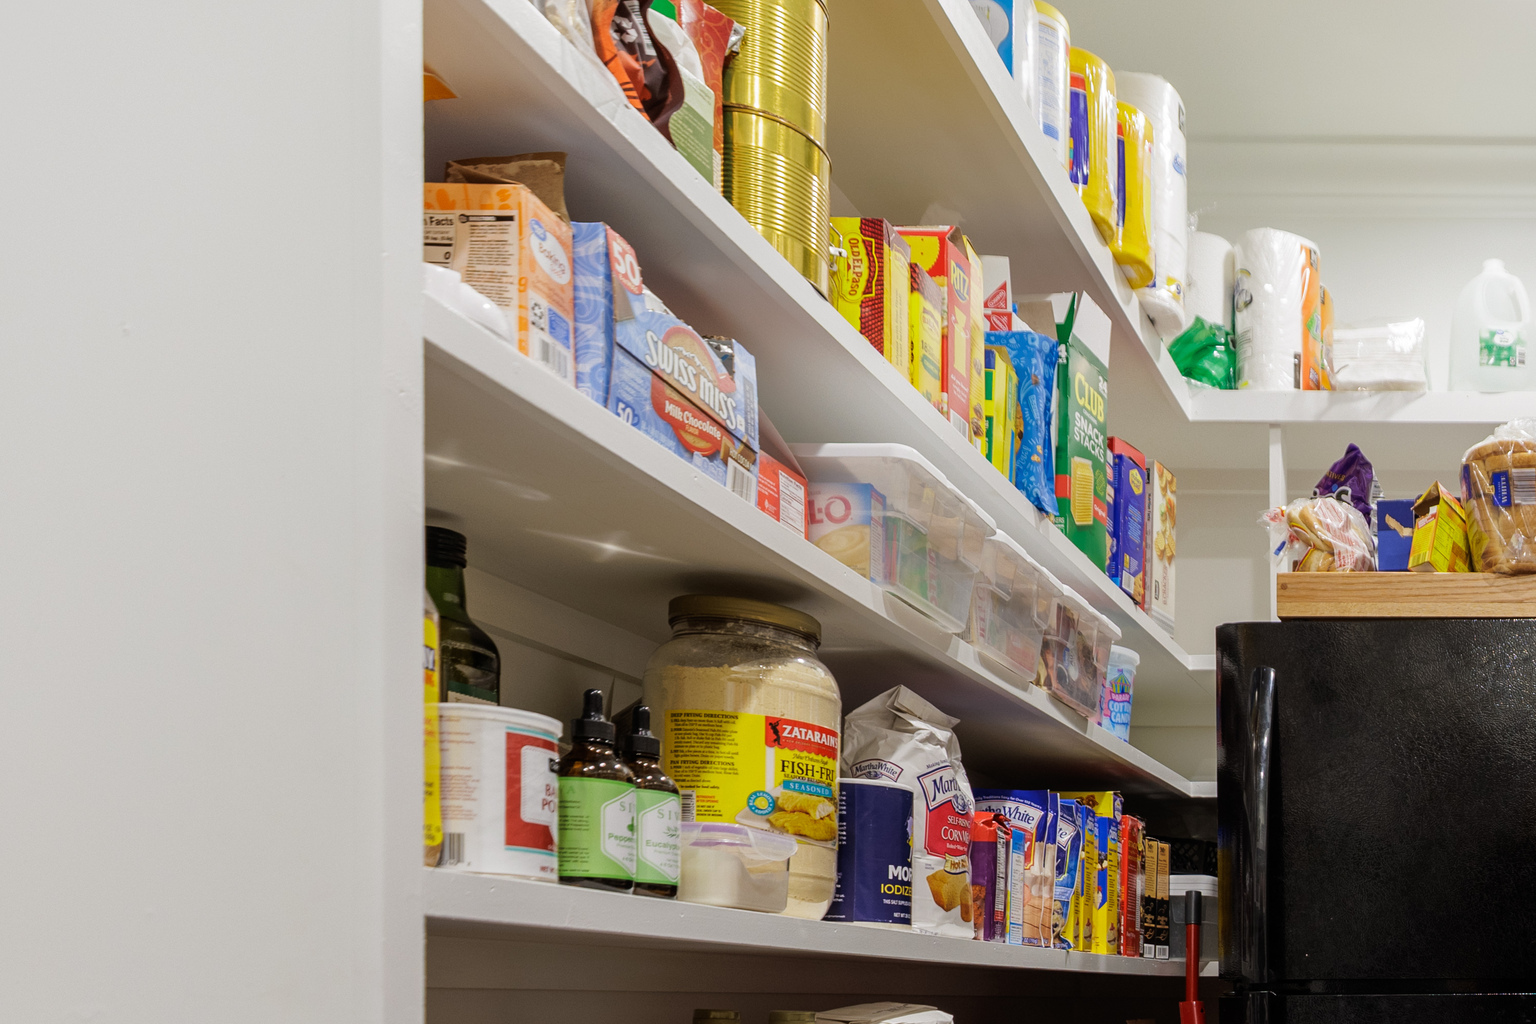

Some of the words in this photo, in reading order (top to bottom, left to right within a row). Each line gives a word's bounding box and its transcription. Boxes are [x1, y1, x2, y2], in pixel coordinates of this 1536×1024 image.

[950, 263, 970, 300] RITZ
[1074, 411, 1104, 446] SNACK
[1074, 430, 1105, 463] STACKS
[783, 781, 832, 796] SEASONED
